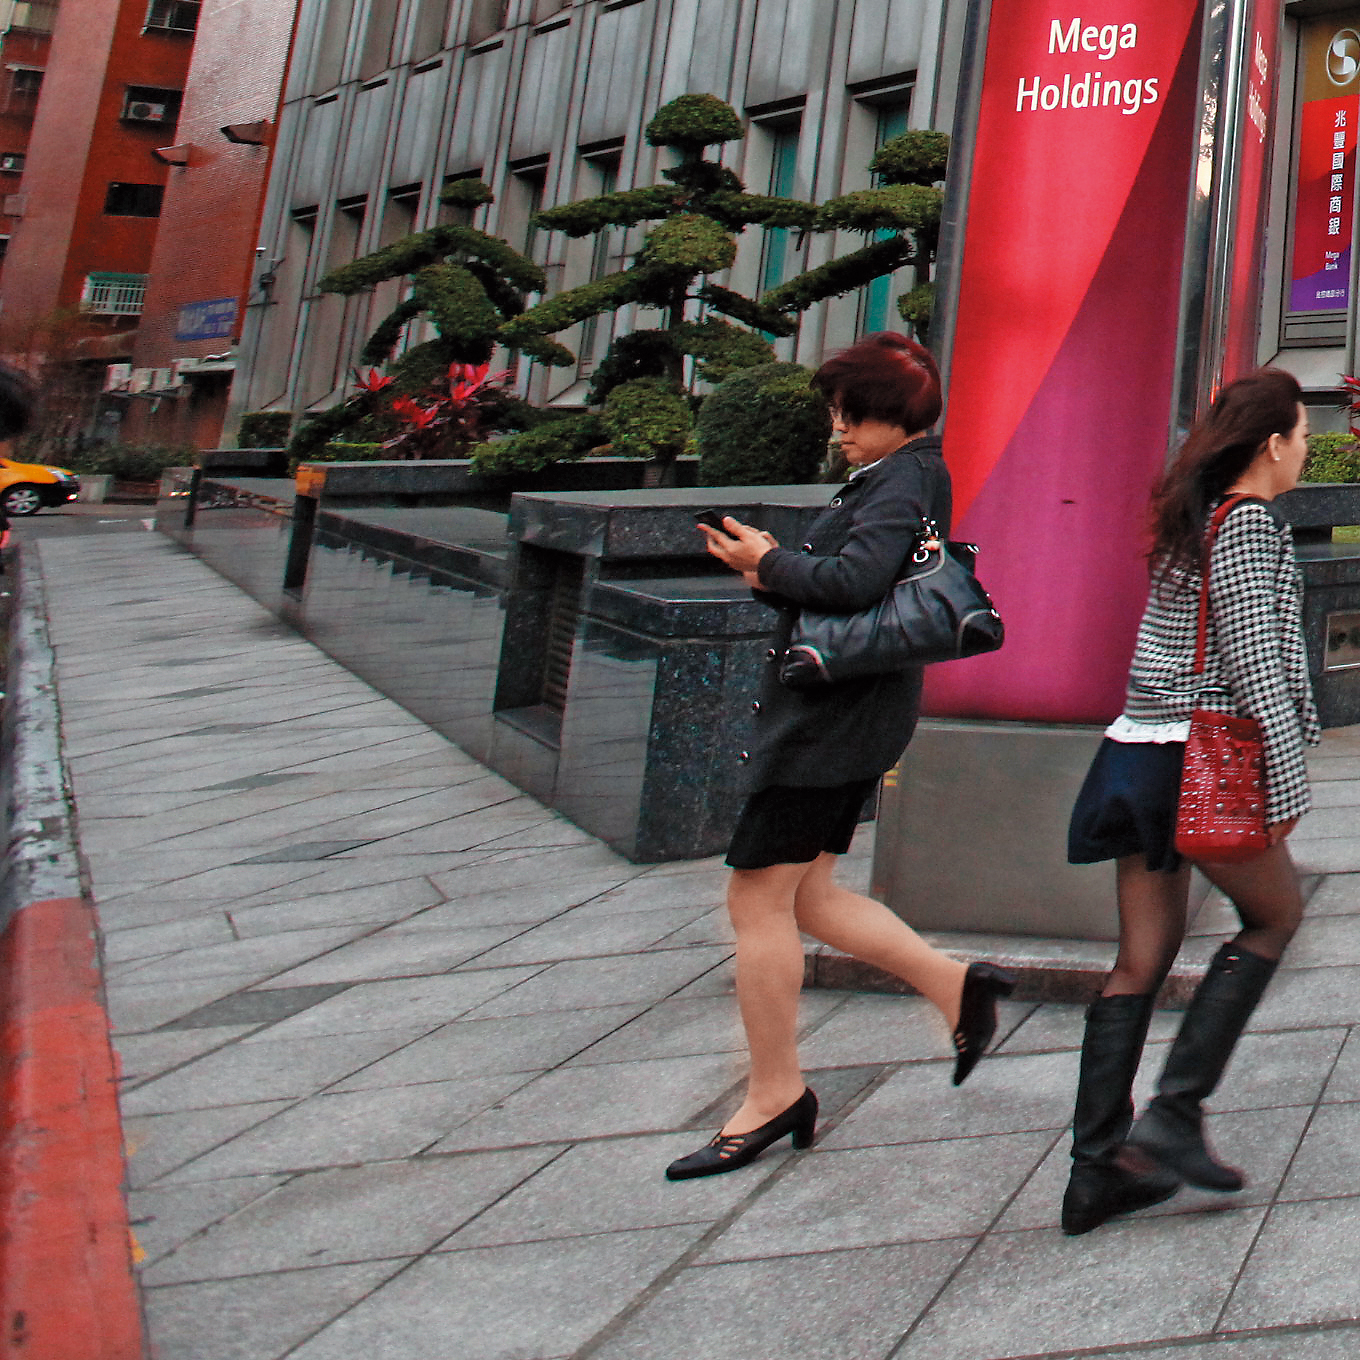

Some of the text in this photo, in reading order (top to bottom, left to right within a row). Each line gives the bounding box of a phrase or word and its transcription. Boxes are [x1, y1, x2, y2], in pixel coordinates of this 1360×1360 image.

[1048, 17, 1137, 60] Mega
[1016, 72, 1159, 115] Holdings
[1327, 110, 1347, 235] 兆豐國際商銀
